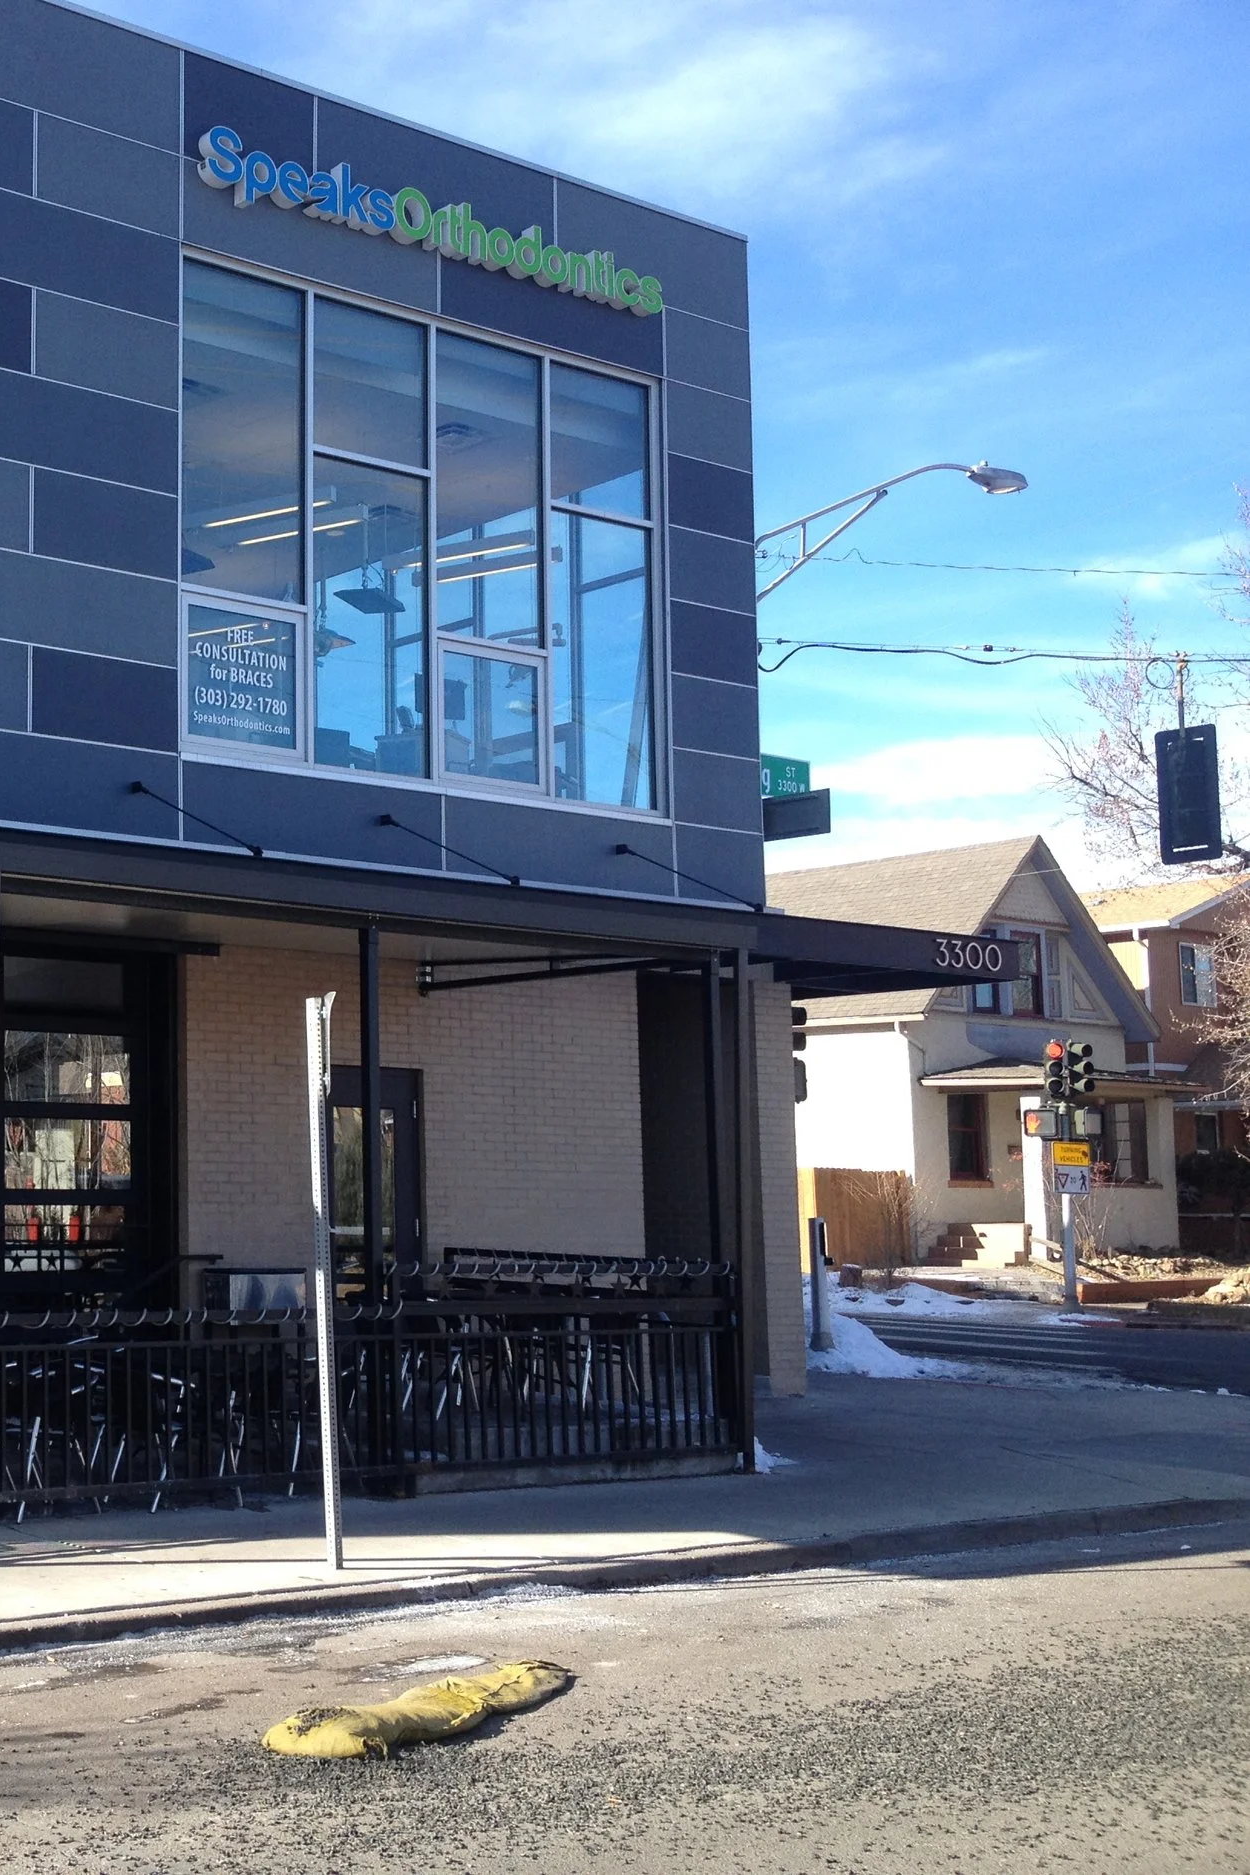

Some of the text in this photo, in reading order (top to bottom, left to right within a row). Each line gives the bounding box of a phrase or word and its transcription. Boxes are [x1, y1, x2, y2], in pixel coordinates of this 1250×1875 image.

[227, 628, 254, 646] FREE
[195, 641, 287, 671] CONSULTATION
[210, 663, 274, 689] for BRACES
[194, 685, 288, 716] (303) 292-1780
[193, 710, 291, 735] SpeaksOrthodontics.com
[785, 766, 796, 778] ST
[778, 779, 797, 793] 3300
[935, 938, 1002, 972] 3300
